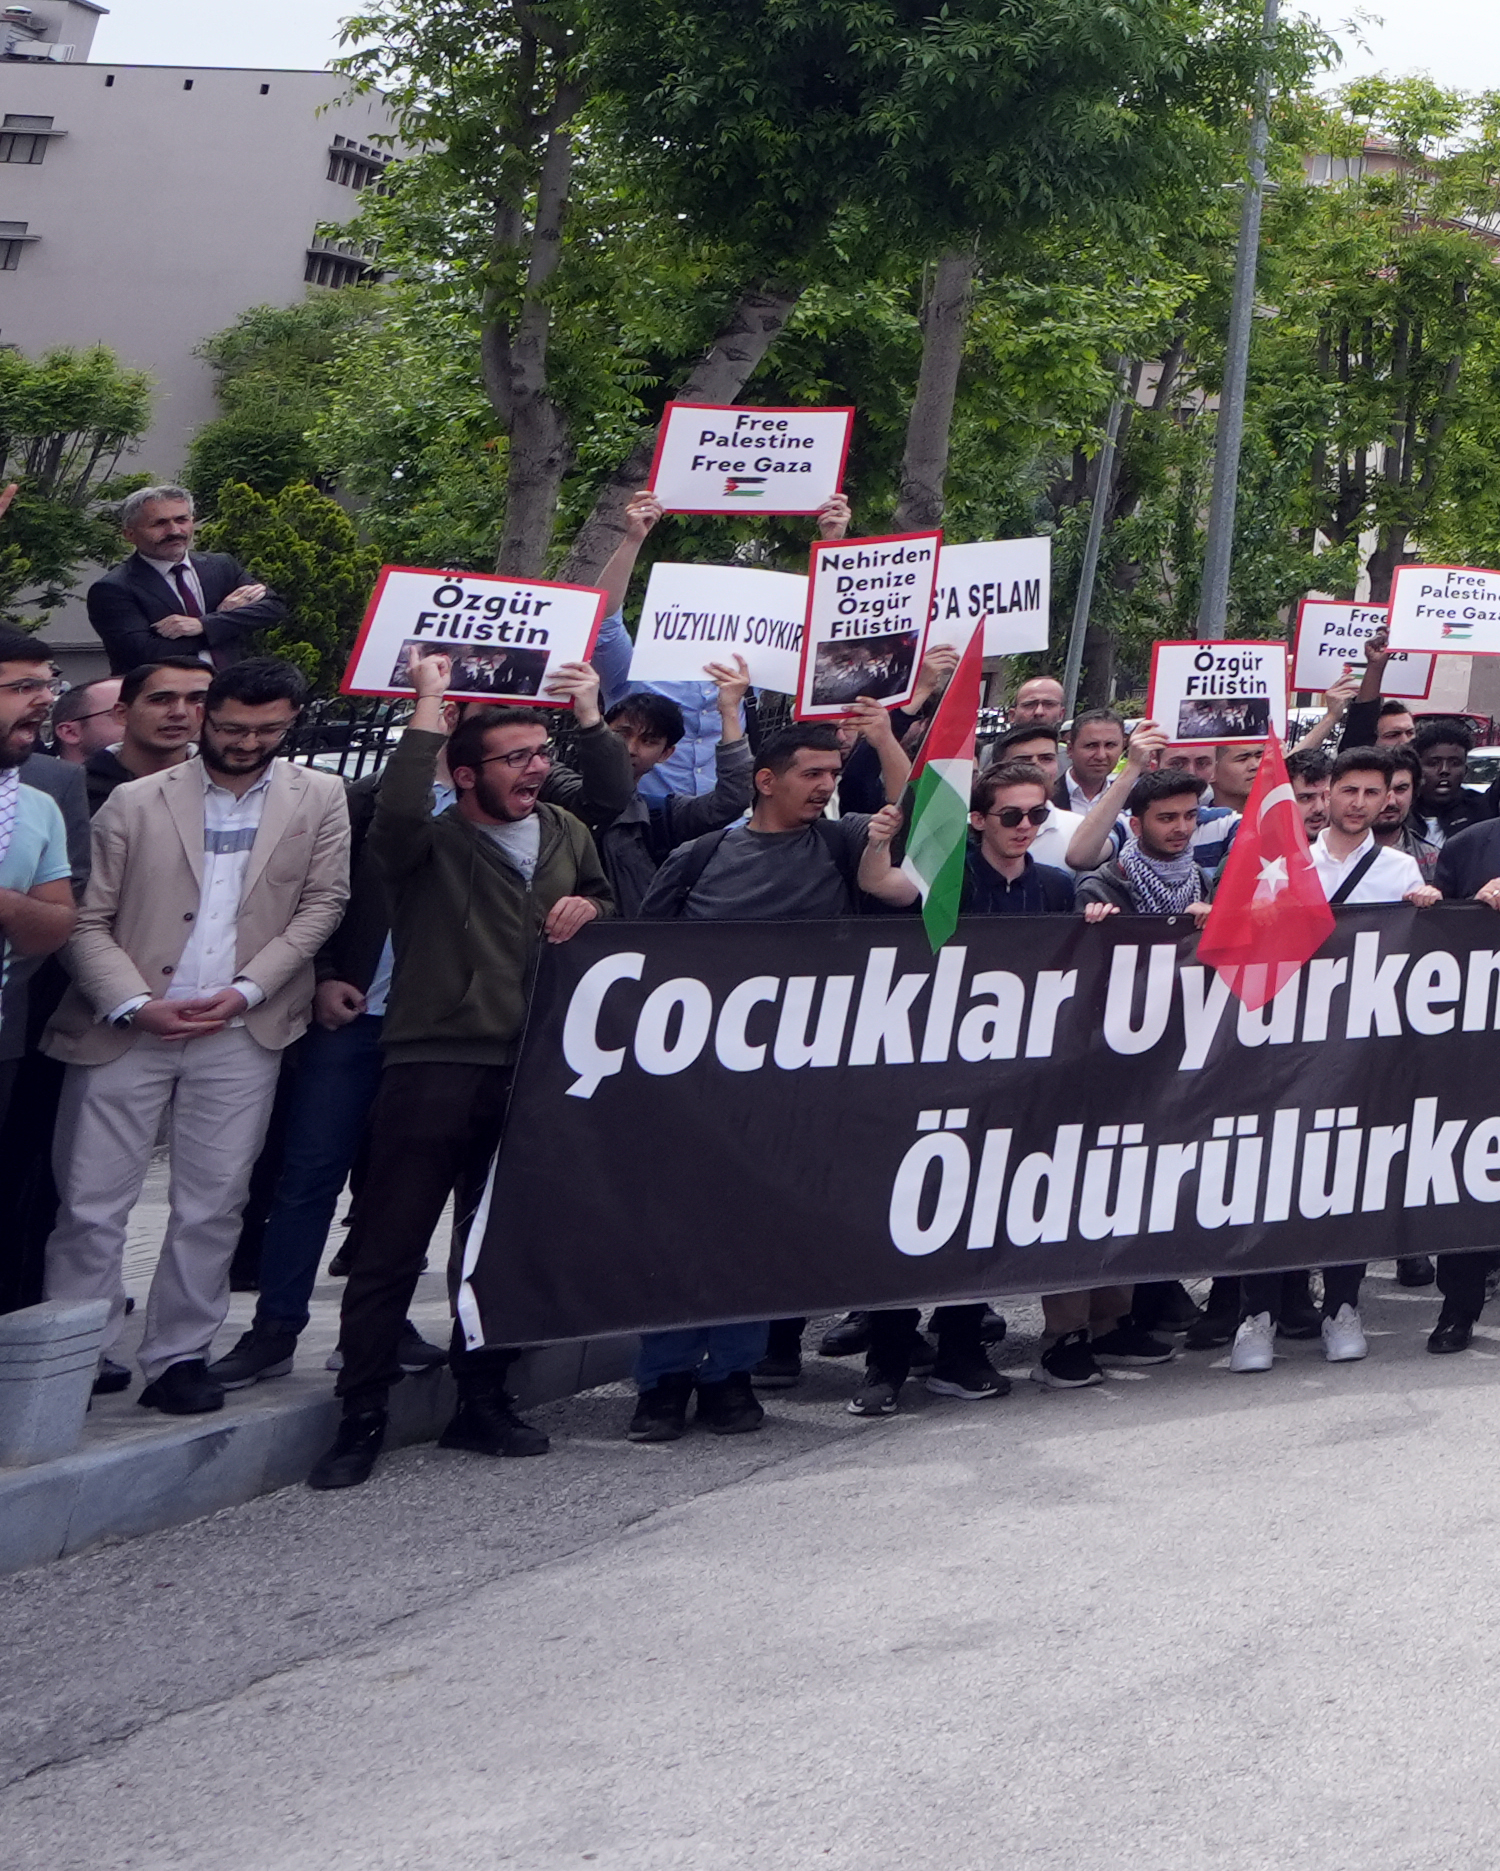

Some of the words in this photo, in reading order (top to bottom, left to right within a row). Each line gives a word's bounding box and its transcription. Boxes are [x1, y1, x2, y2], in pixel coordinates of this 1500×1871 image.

[735, 414, 789, 432] Free
[699, 431, 815, 449] Palestine
[691, 455, 746, 473] Free
[753, 456, 812, 473] Gaza
[821, 546, 931, 572] Nehirden
[836, 571, 916, 594] Denize
[1446, 572, 1486, 588] Free
[433, 577, 552, 621] Özgür
[838, 592, 912, 619] Özgür
[968, 579, 1041, 618] SELAM
[1415, 605, 1457, 620] Free
[413, 612, 549, 645] Filistin
[652, 604, 739, 642] YÜZYILIN
[743, 616, 804, 653] SOYKIR
[830, 614, 912, 639] Filistin
[1323, 623, 1373, 638] Pales
[1194, 645, 1264, 678] Özgür
[1318, 643, 1358, 658] Free
[1388, 651, 1408, 661] za
[1186, 675, 1267, 696] Filistin
[562, 944, 1077, 1099] Çocuklar
